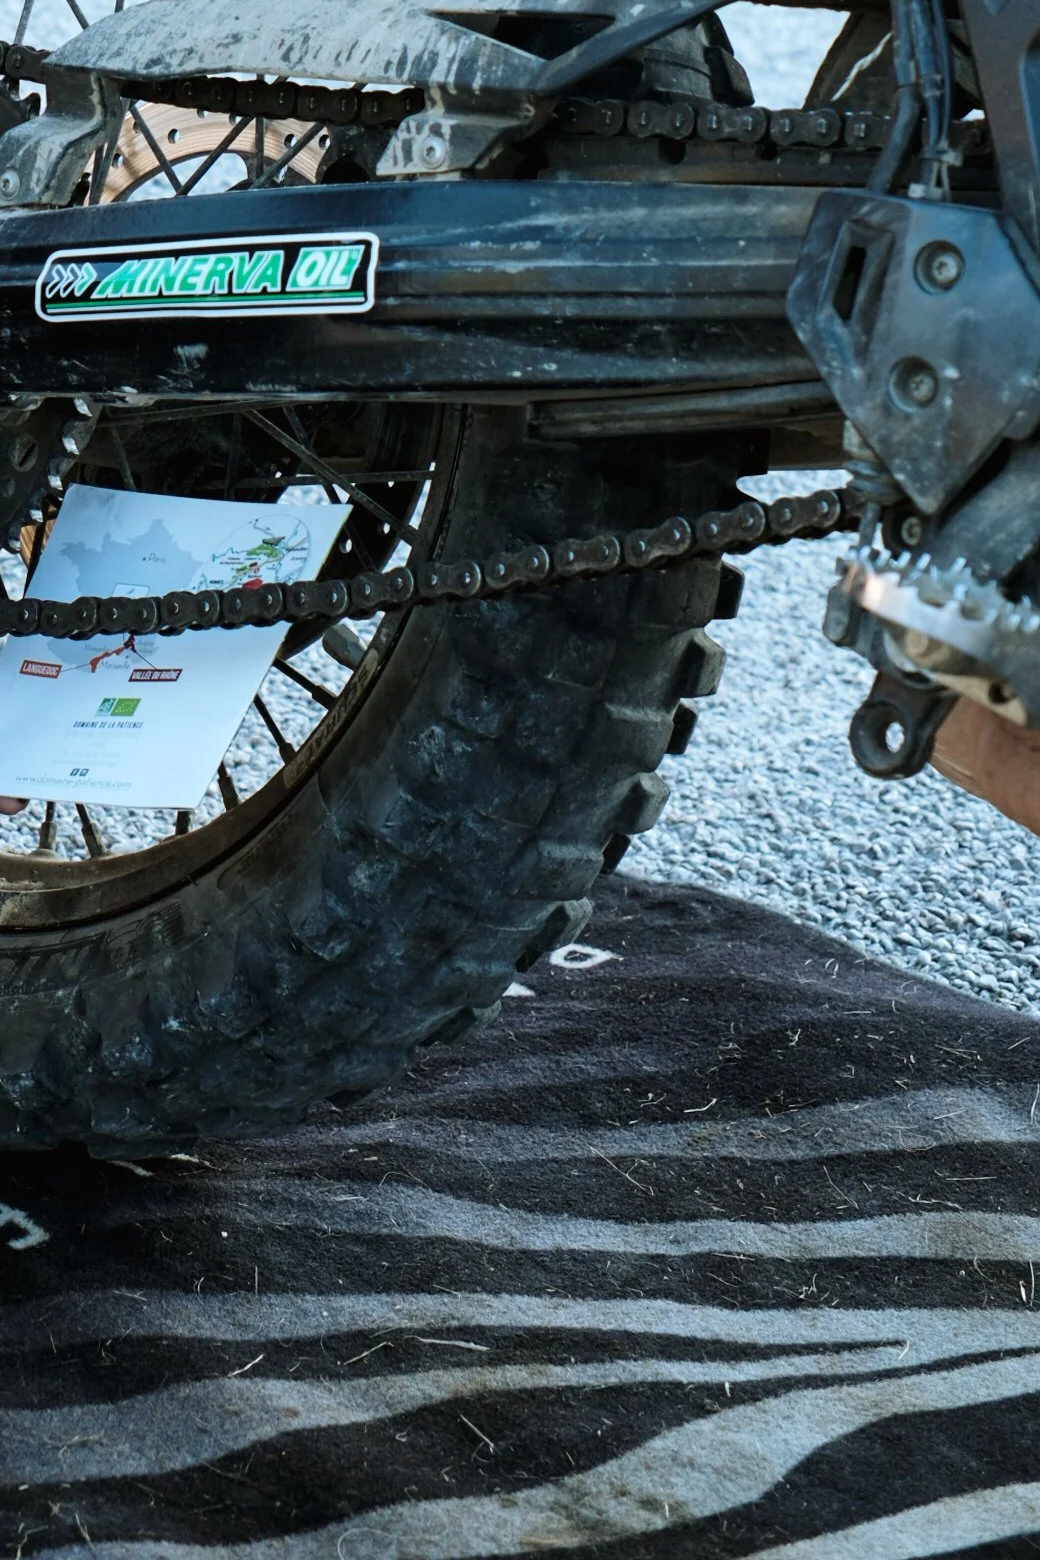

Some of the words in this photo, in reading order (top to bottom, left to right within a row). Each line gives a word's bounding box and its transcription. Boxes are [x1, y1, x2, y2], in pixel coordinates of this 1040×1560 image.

[90, 250, 285, 299] MINERVA
[293, 246, 356, 288] OIL
[22, 661, 60, 677] LANGUEDOC
[72, 720, 98, 728] DOMAINE
[99, 720, 109, 728] DE
[109, 720, 117, 728] LA
[117, 720, 144, 728] PATIENCE
